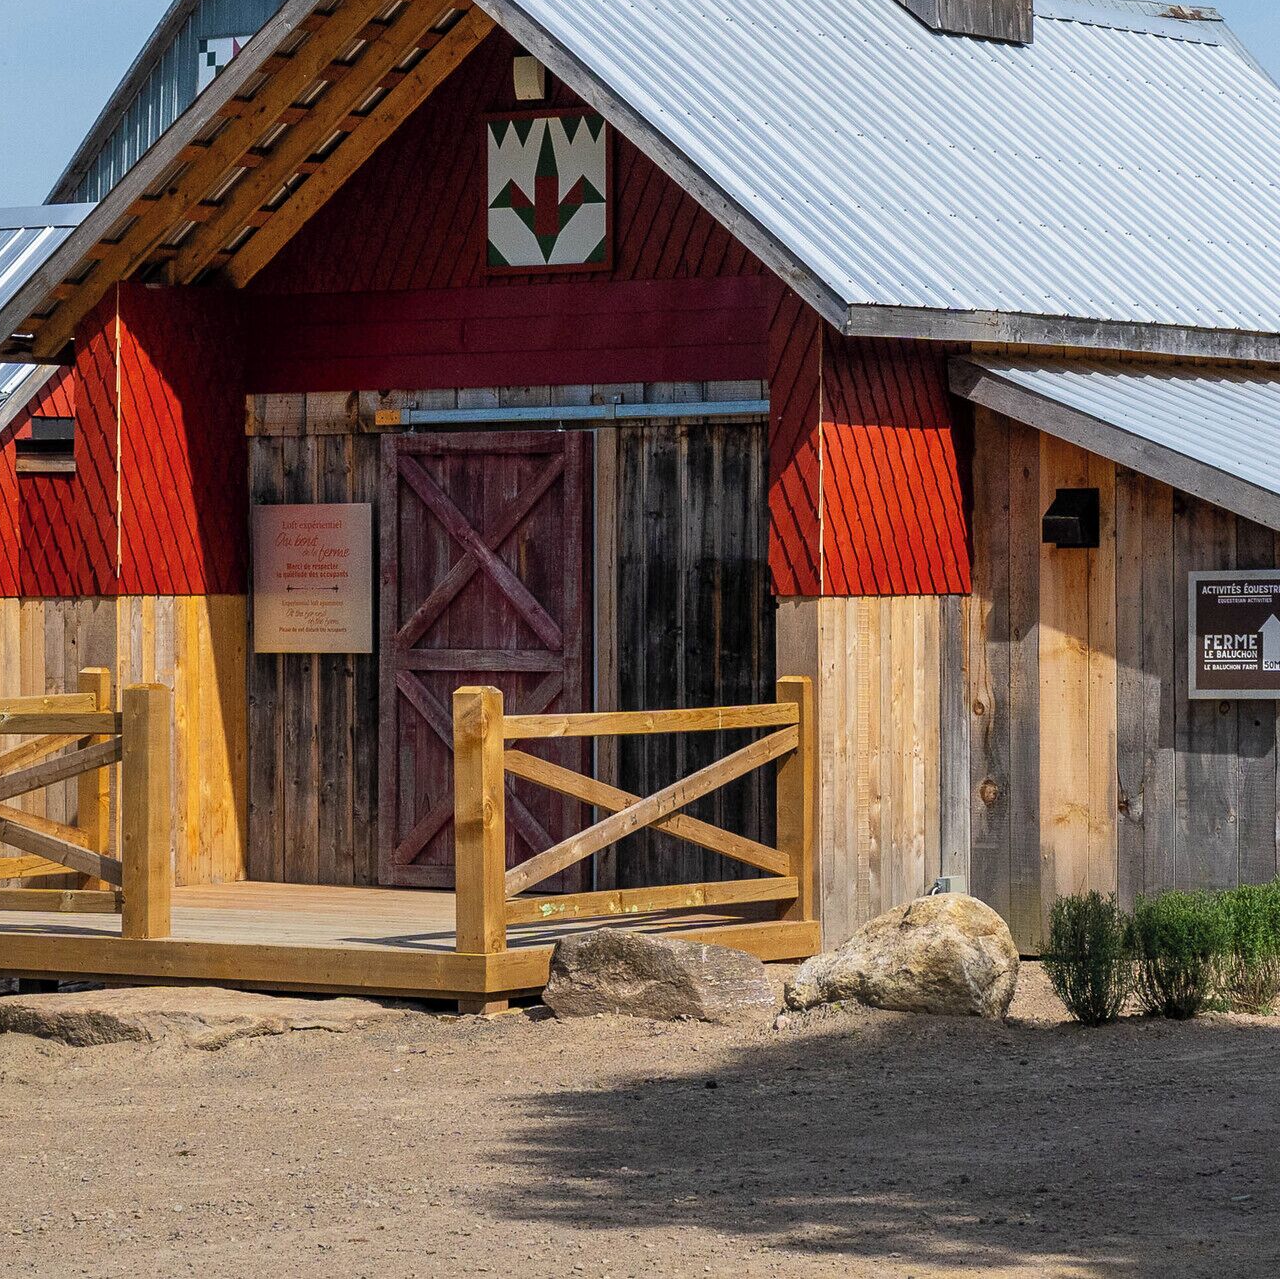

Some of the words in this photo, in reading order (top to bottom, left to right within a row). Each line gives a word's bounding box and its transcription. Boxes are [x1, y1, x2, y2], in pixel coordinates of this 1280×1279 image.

[282, 520, 298, 530] Loft
[318, 544, 350, 562] ferme
[319, 570, 349, 579] occupants
[1201, 583, 1242, 595] ACTIVITÉS
[1204, 634, 1258, 650] FERME
[1204, 650, 1214, 659] LE
[1216, 650, 1258, 659] BALUCHON
